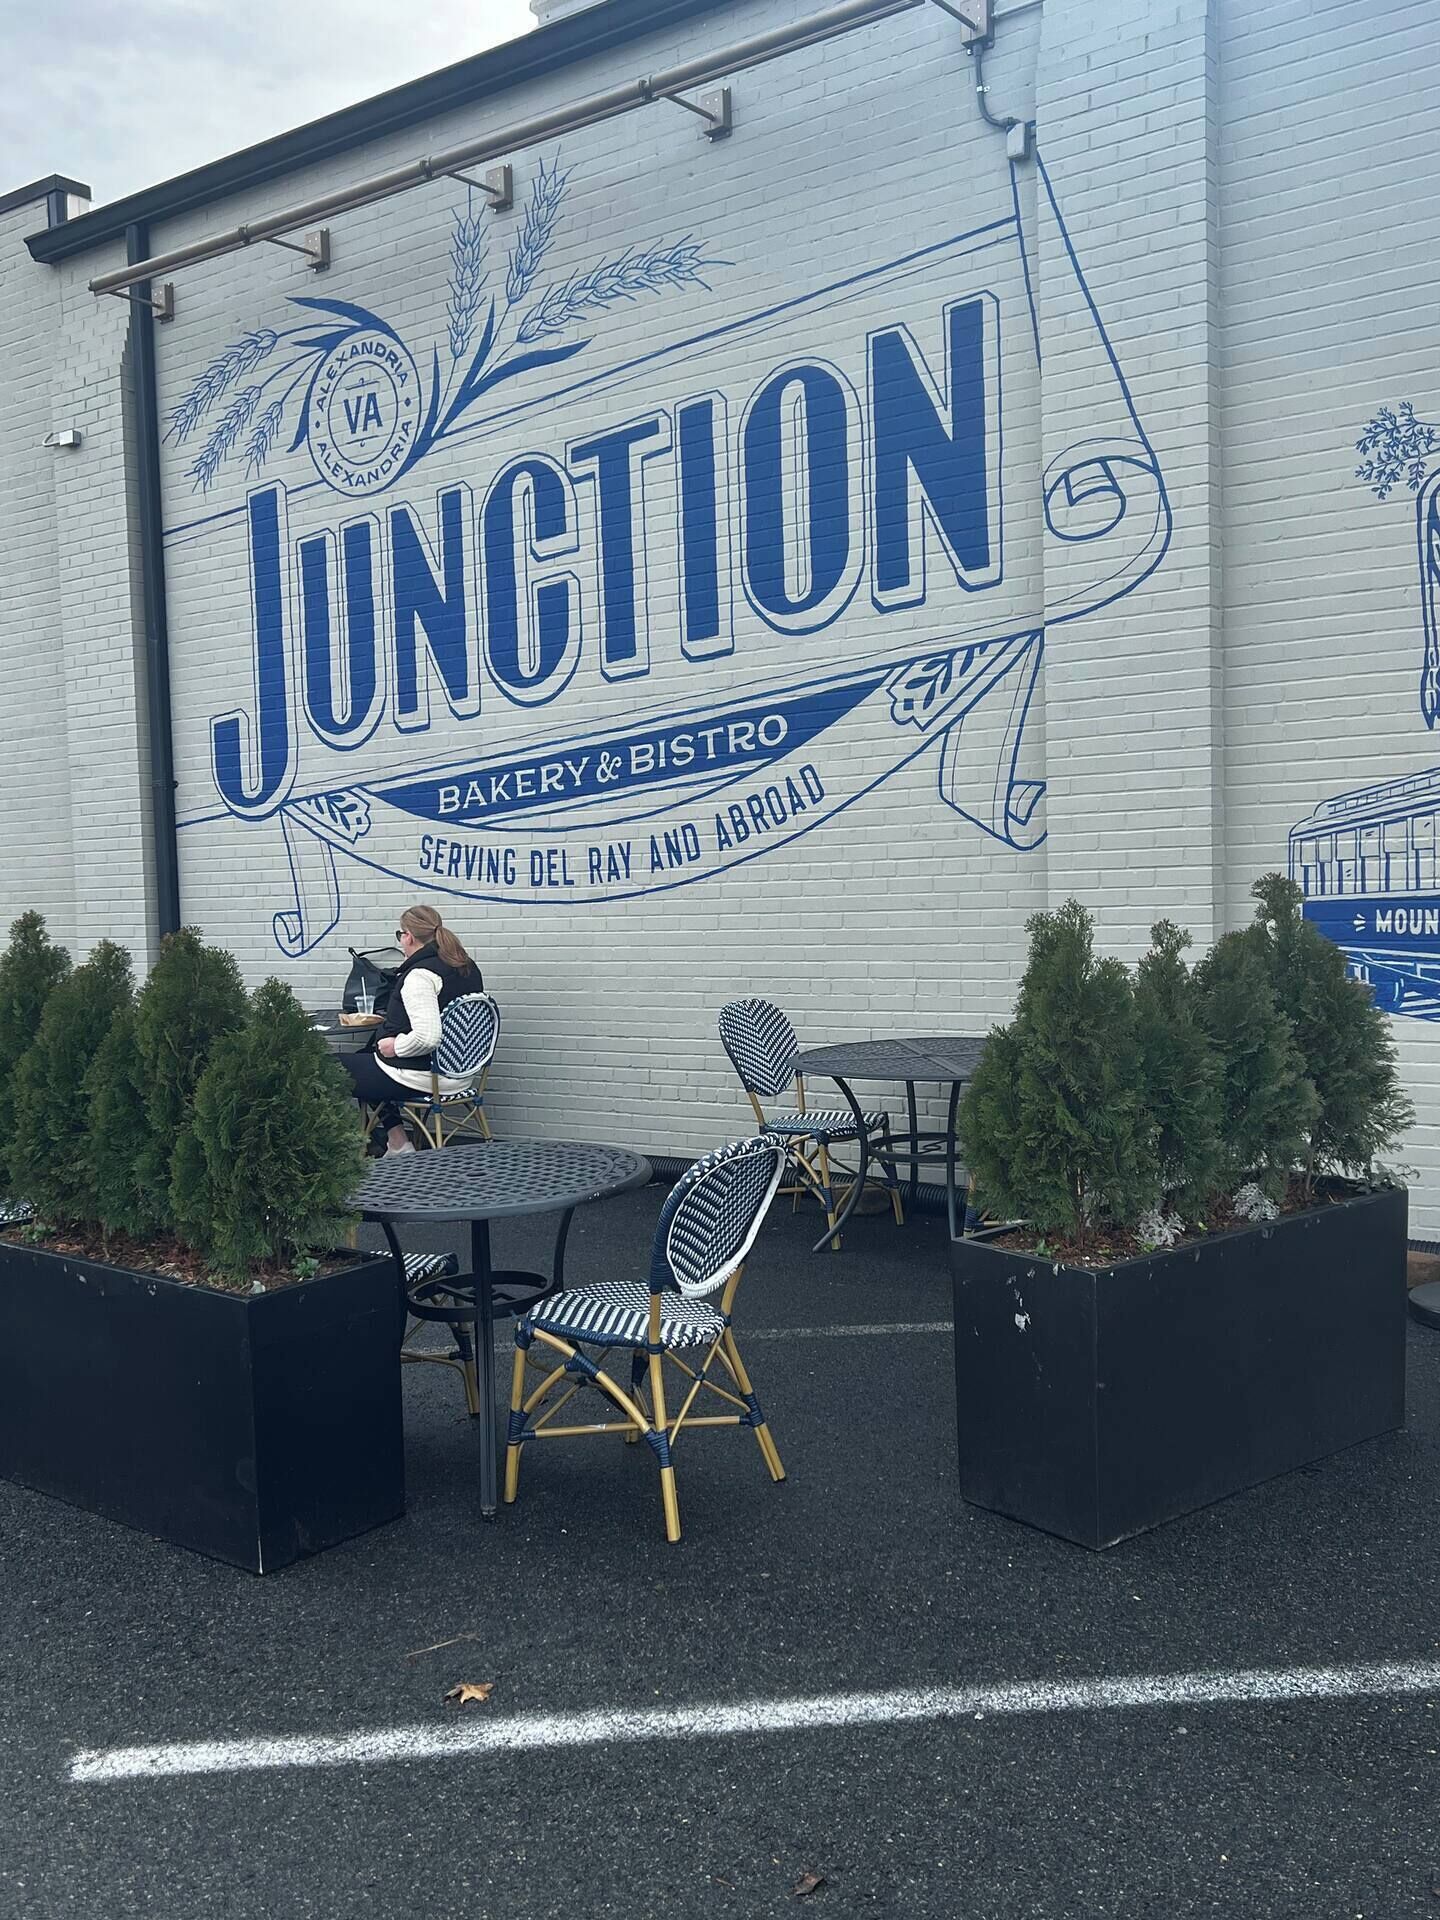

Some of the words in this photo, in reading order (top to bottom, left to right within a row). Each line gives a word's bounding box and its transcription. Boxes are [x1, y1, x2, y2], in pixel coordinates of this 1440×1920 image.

[316, 341, 409, 413] ALEXANDRIA
[343, 392, 383, 435] VA
[316, 419, 413, 487] ALEXANDRIA
[210, 290, 1002, 821] JUNCTION
[437, 757, 590, 815] BAKERY
[596, 750, 622, 783] &
[628, 713, 789, 774] BISTRO
[419, 834, 516, 886] SERVING
[530, 849, 575, 887] DEL
[589, 841, 631, 885] RAY
[649, 822, 701, 874] AND
[714, 763, 826, 852] ABROAD
[1375, 908, 1440, 935] MOUN
